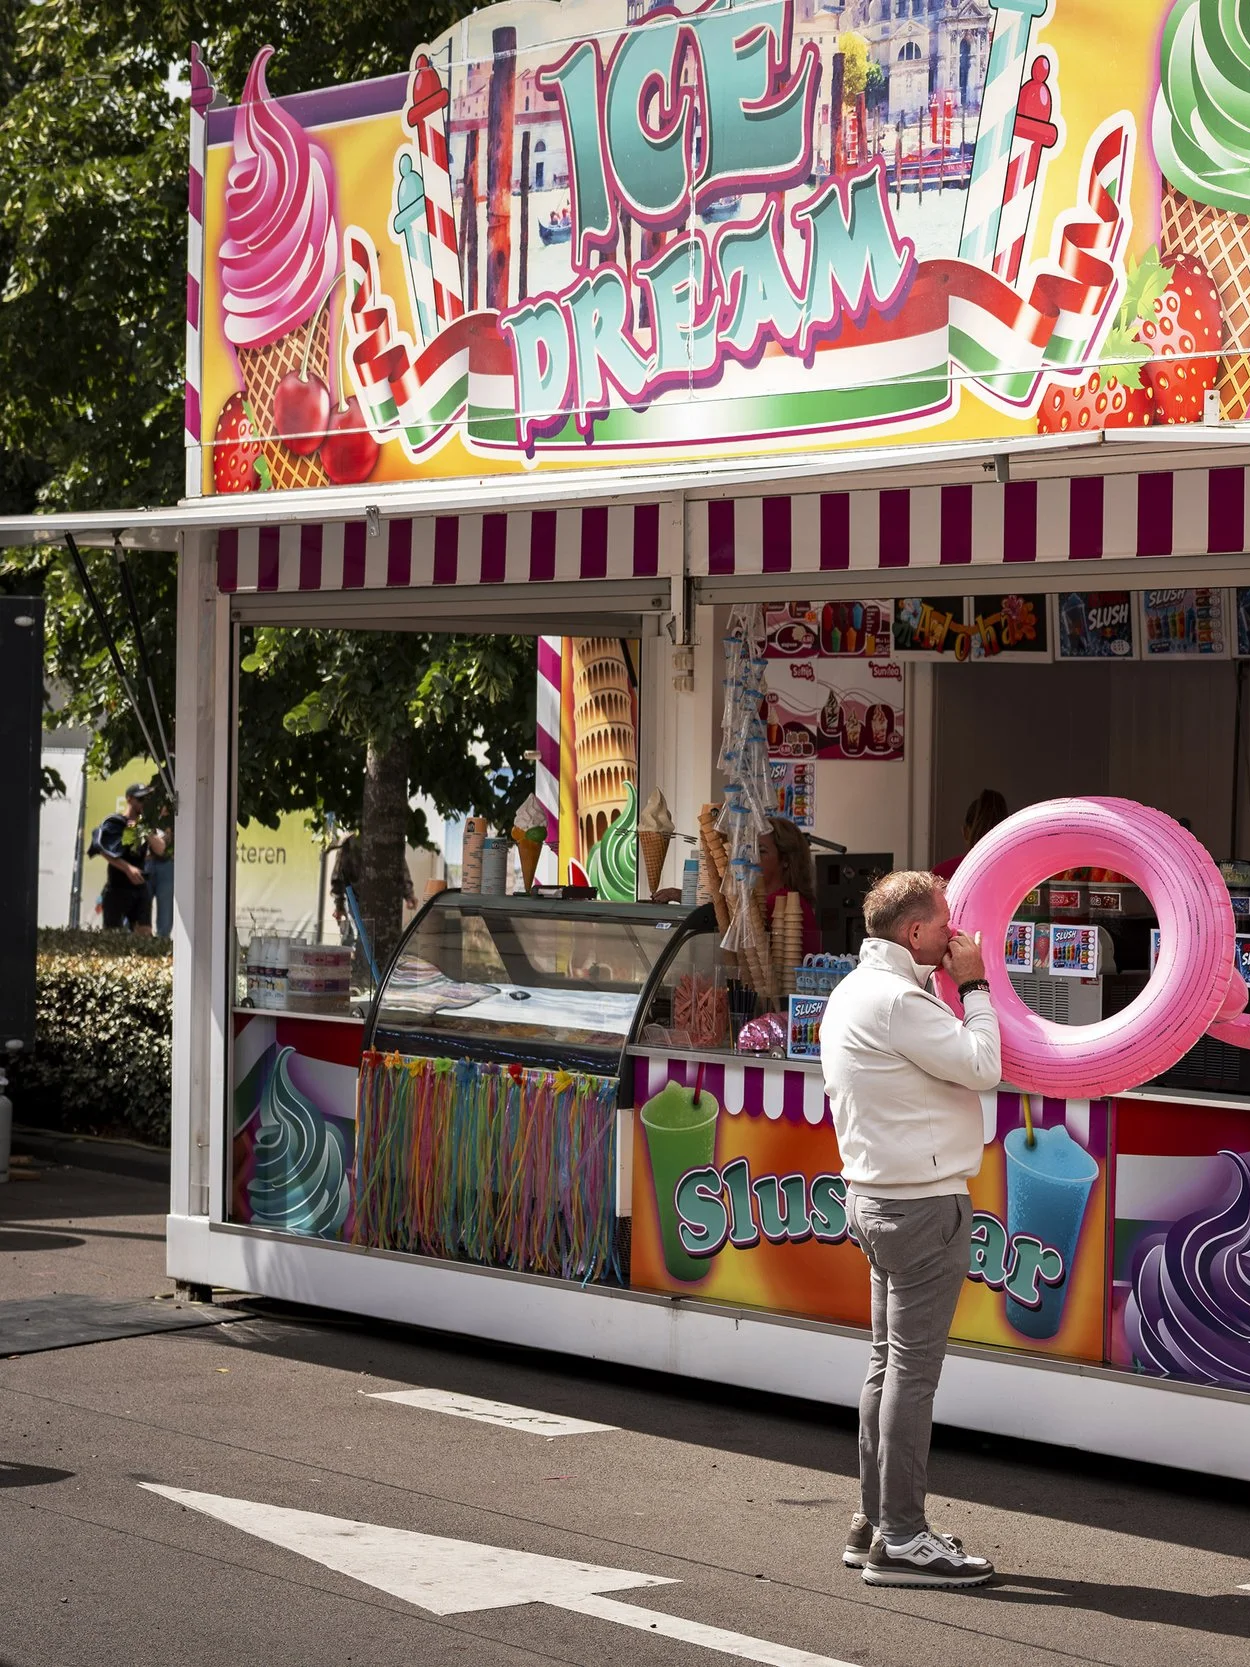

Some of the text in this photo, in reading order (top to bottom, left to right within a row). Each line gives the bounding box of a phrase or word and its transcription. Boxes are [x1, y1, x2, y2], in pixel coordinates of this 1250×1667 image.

[536, 0, 820, 271] ICE
[498, 157, 916, 450] DREAM
[915, 603, 1018, 662] Aloha
[1087, 603, 1130, 631] SLUSH
[236, 843, 286, 866] teren
[1055, 929, 1078, 942] SLUSH
[794, 1001, 824, 1018] SLUSH
[674, 1155, 1067, 1312] Slus ar
